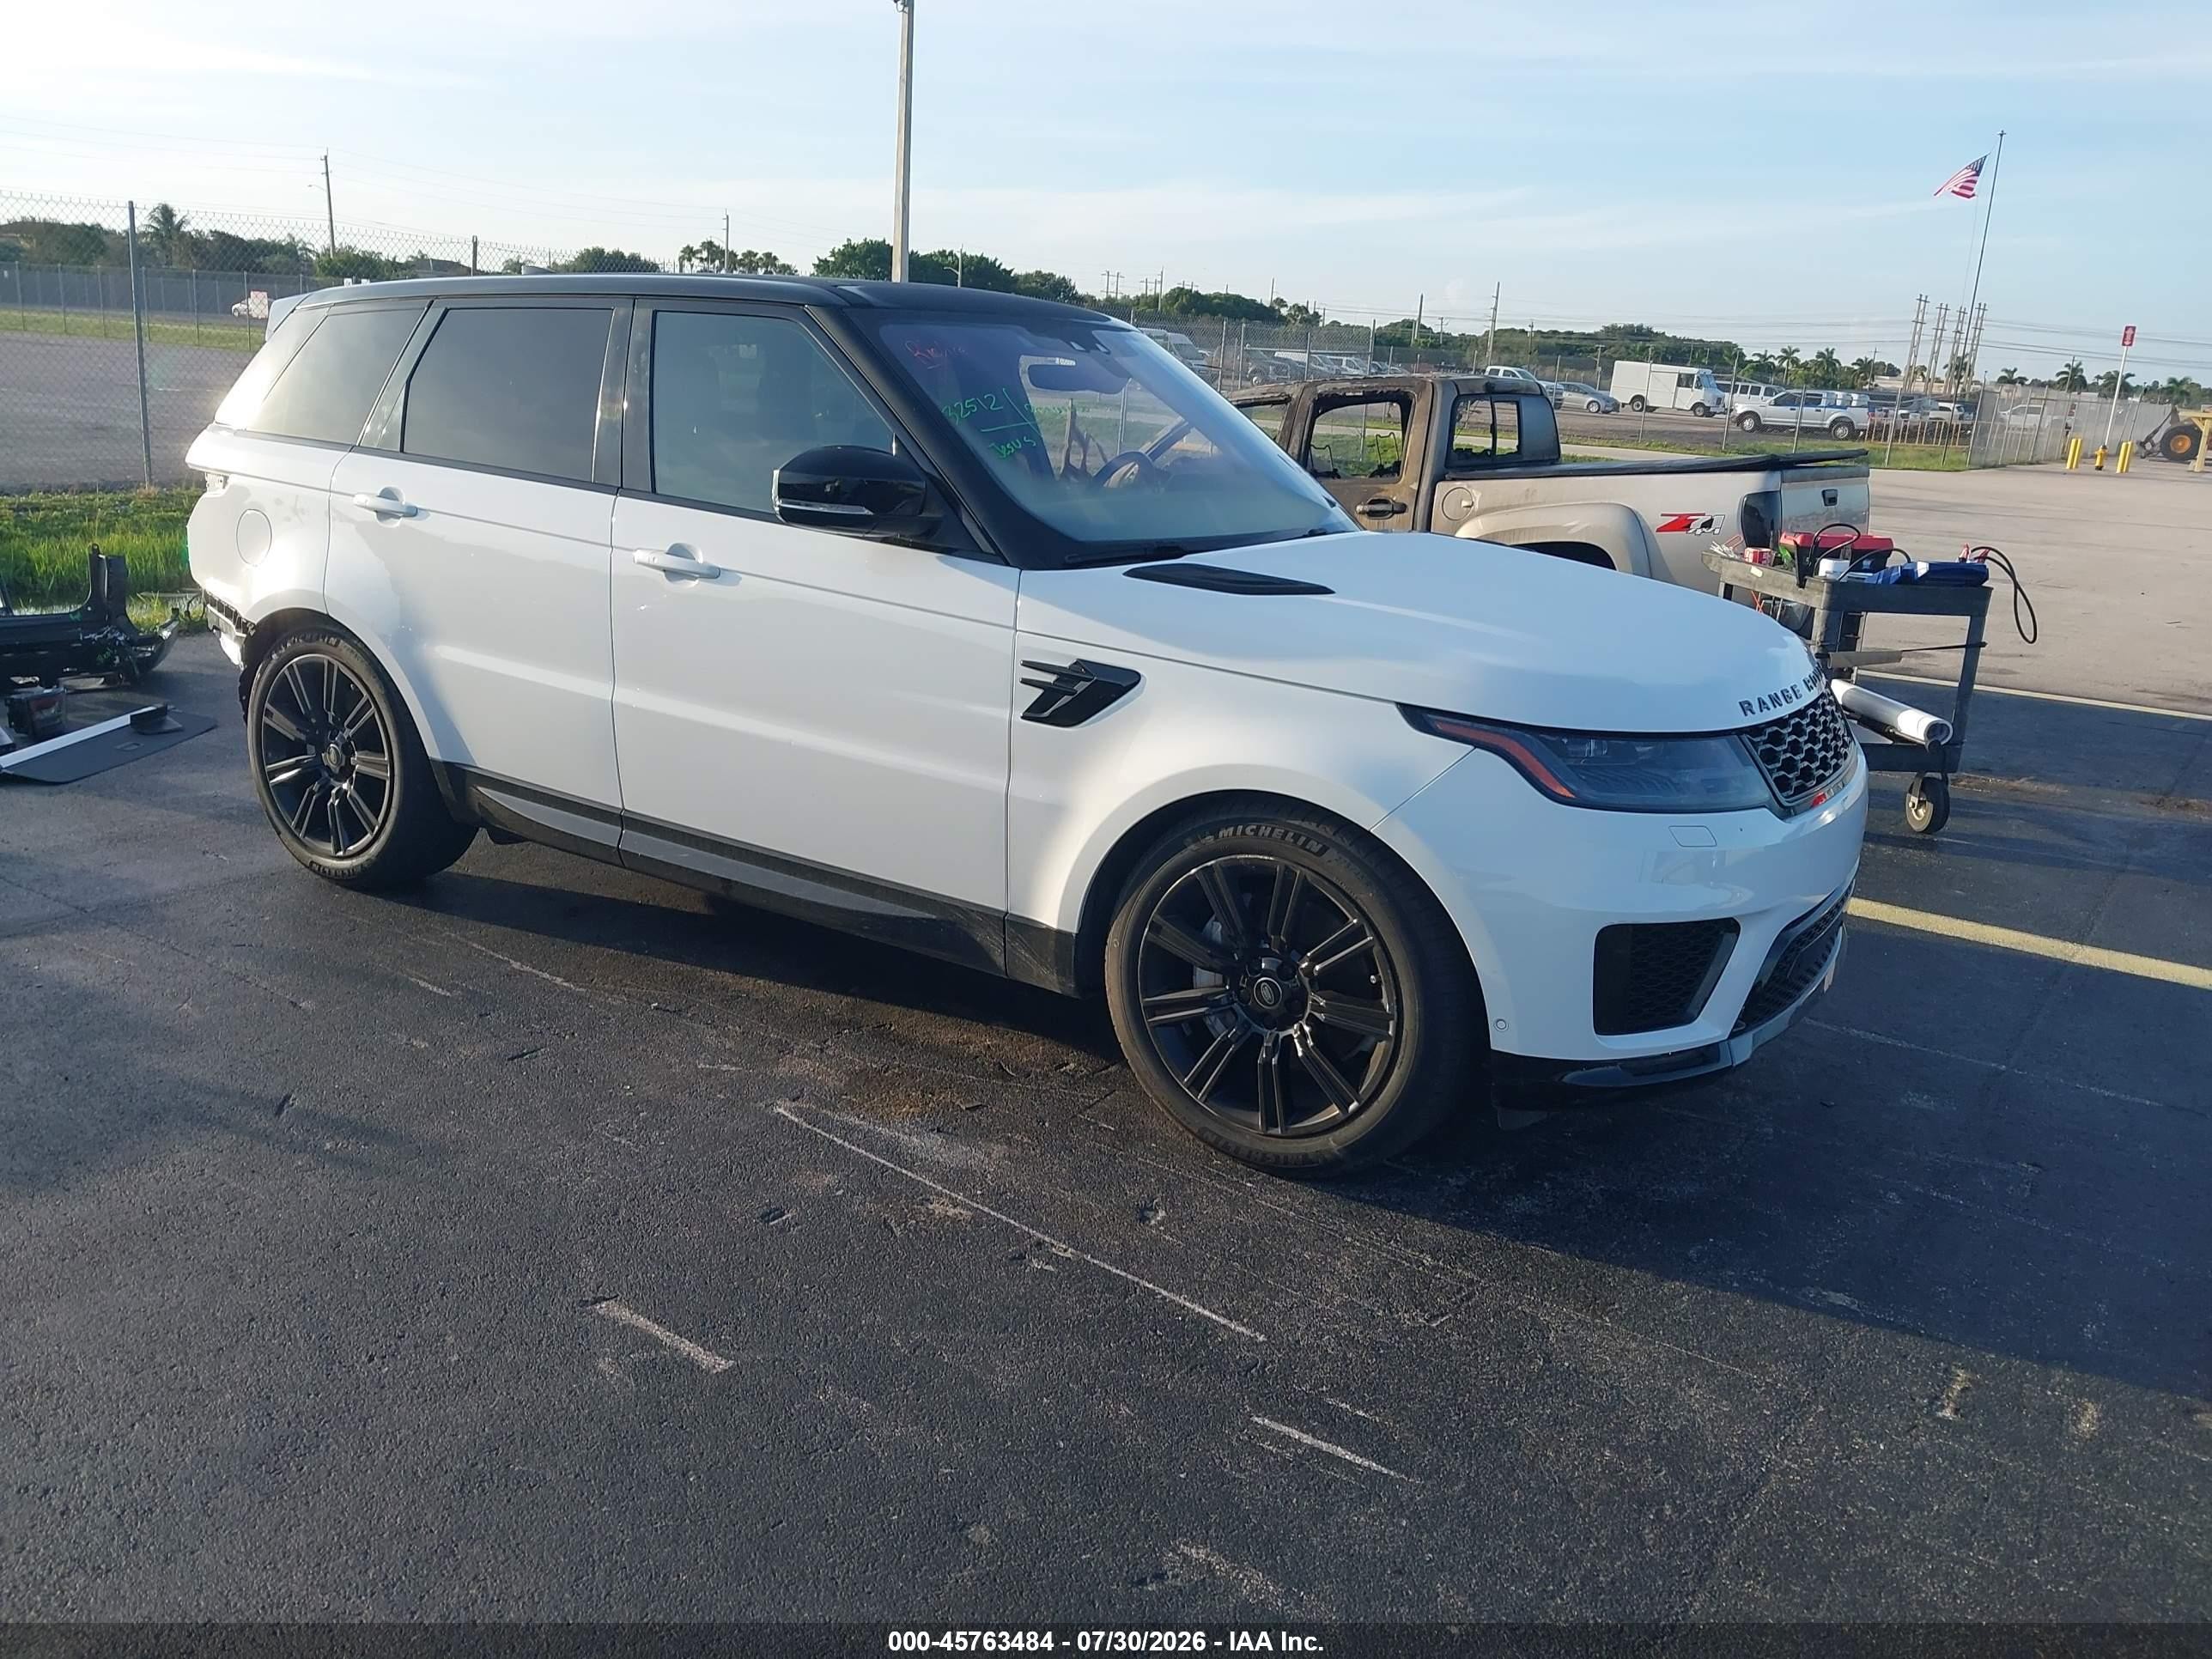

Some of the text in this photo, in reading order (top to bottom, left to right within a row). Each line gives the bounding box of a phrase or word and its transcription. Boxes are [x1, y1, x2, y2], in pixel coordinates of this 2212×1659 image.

[1655, 513, 1725, 536] Z71
[1738, 684, 1802, 717] RANGE
[1218, 824, 1323, 854] MICHELIN
